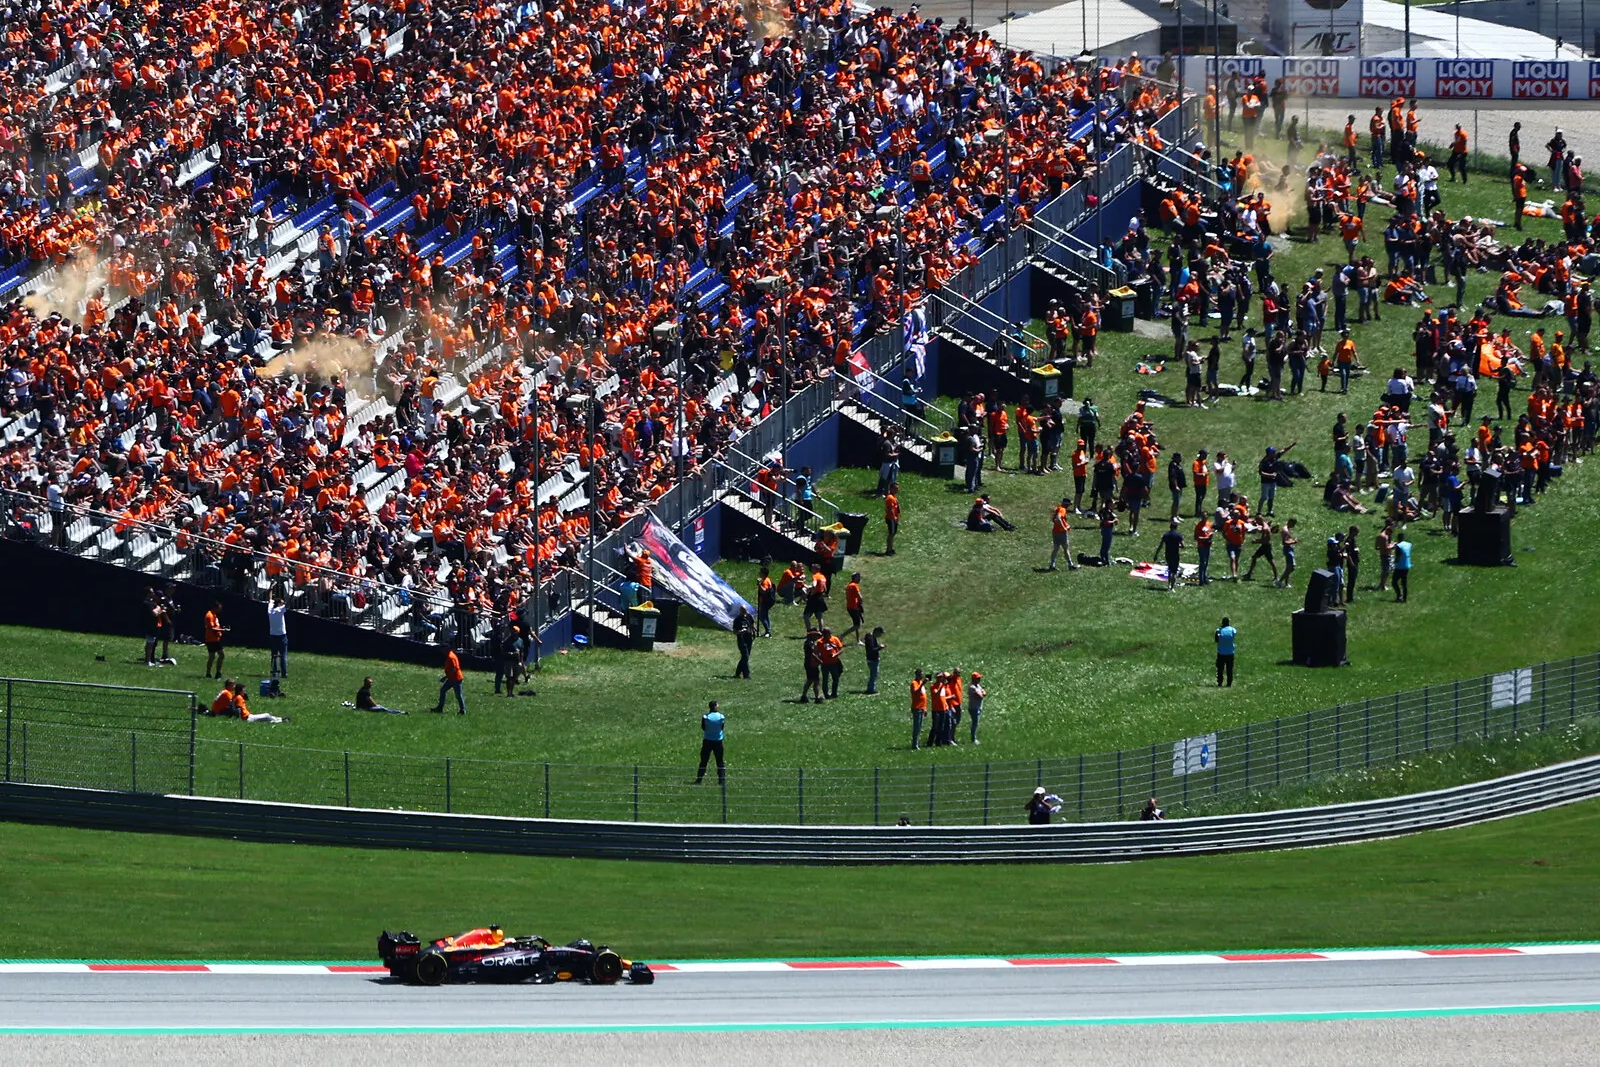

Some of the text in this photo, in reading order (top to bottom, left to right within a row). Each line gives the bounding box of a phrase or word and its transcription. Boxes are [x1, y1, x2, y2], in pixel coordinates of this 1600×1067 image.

[1285, 60, 1337, 77] LIQUI
[1361, 60, 1413, 78] LIQUI
[1438, 60, 1491, 78] LIQUI
[1514, 61, 1566, 79] LIQUI
[1284, 79, 1338, 95] MOLY
[1360, 79, 1415, 96] MOLY
[1437, 79, 1493, 96] MOLY
[1514, 80, 1569, 97] MOLY
[481, 956, 540, 968] ORACLE
